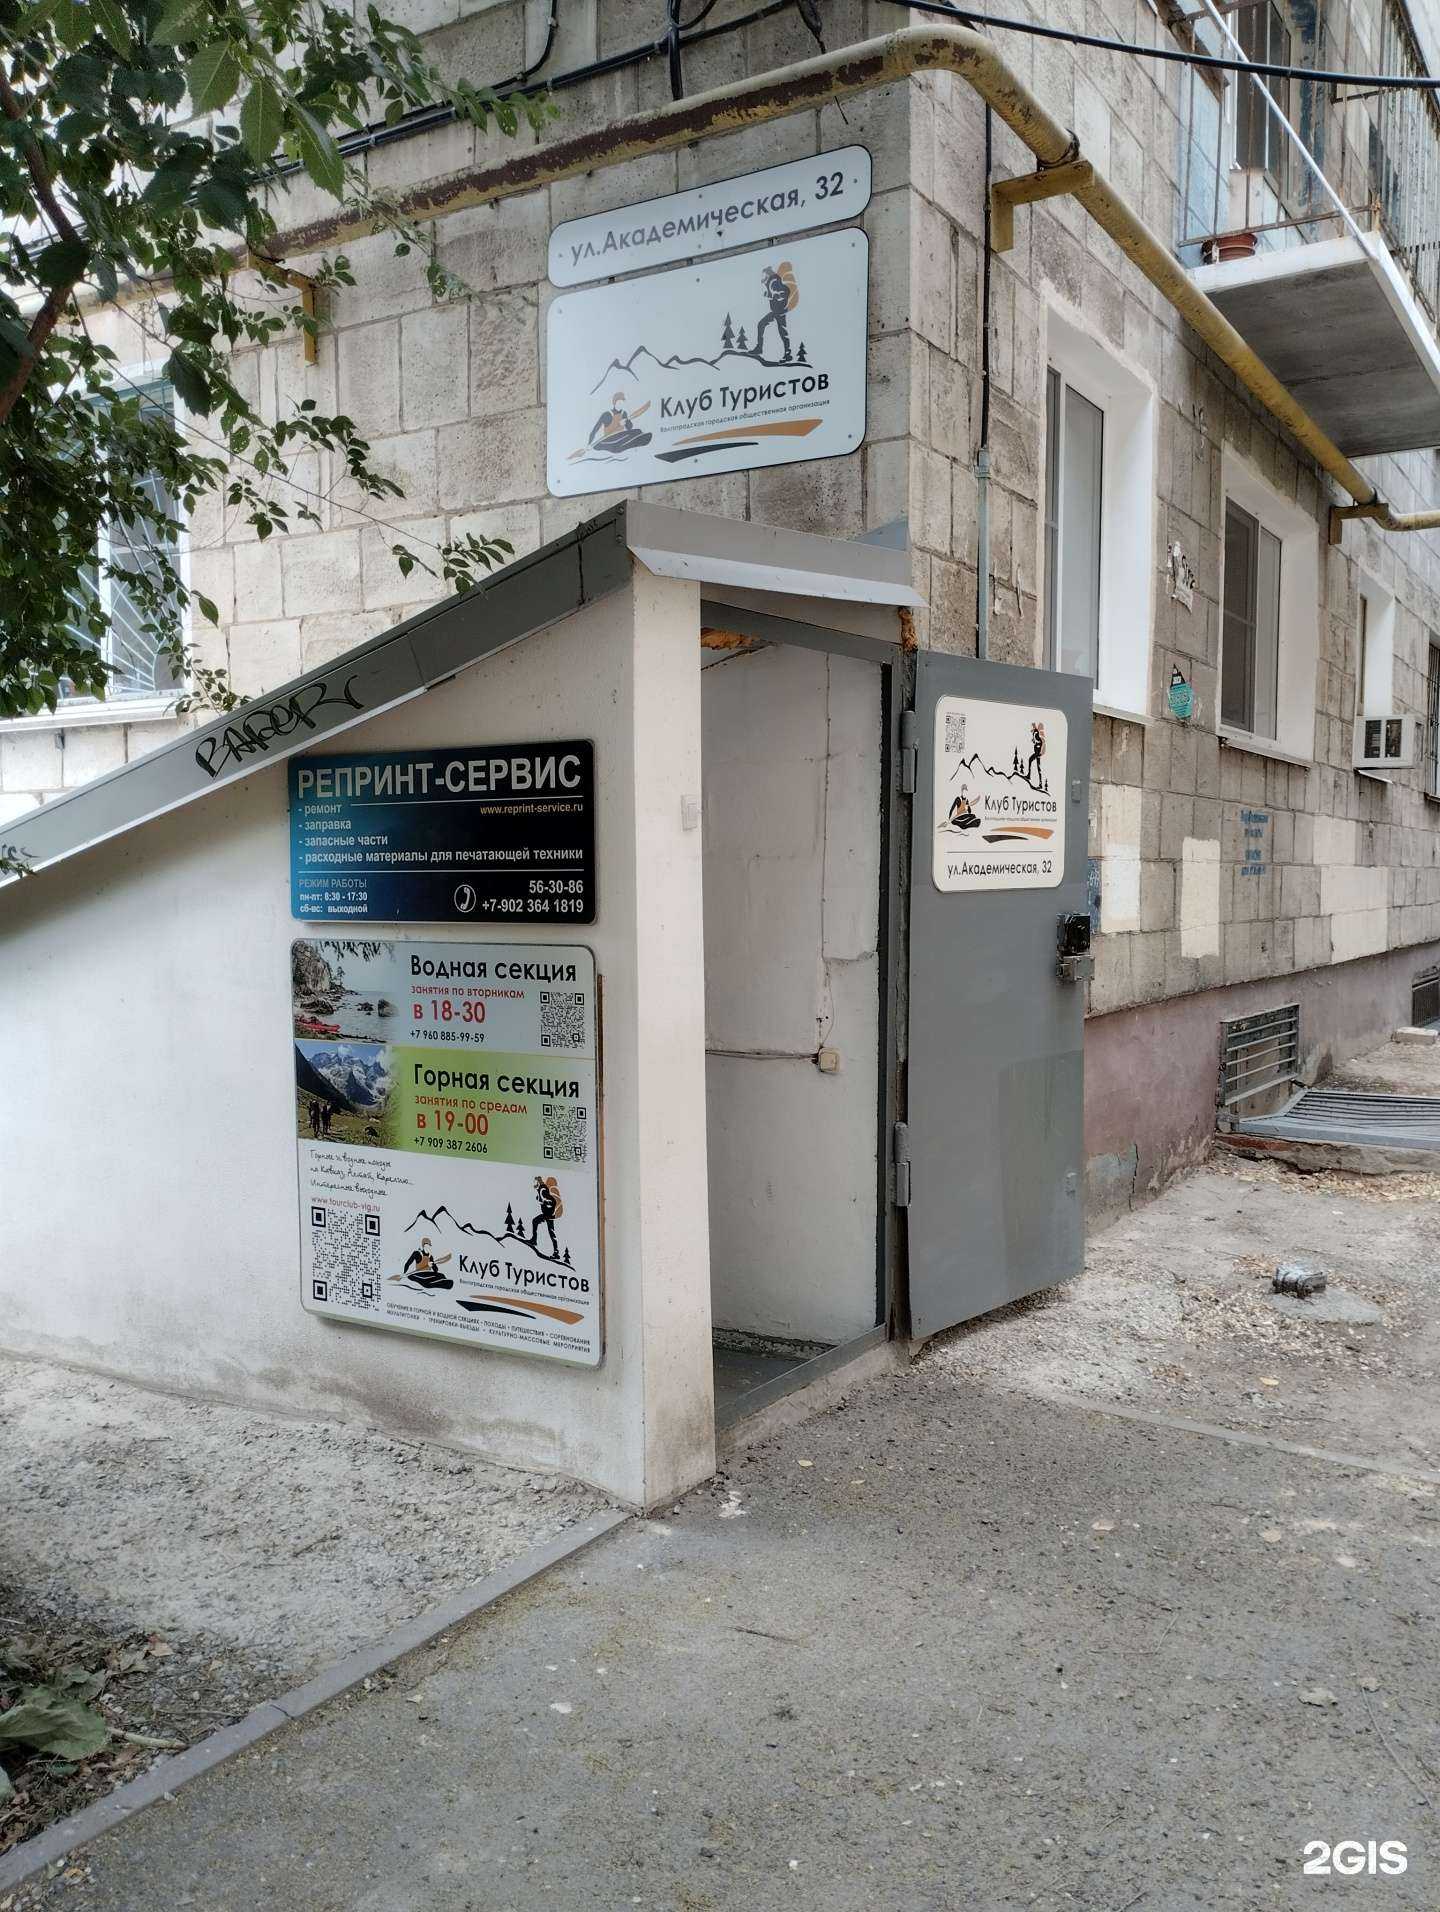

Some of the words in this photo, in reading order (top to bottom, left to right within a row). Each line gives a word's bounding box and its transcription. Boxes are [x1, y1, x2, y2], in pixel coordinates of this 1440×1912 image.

[571, 186, 806, 266] ул.Академическая,
[814, 171, 844, 200] 32
[660, 388, 713, 419] Клуб
[719, 373, 829, 411] Туристов
[298, 754, 581, 799] РЕПРИНТ-СЕРВИС
[304, 803, 342, 817] ремонт
[480, 802, 584, 816] www.reprint-service.ru
[984, 795, 1009, 814] Клуб
[1011, 796, 1057, 815] Туристов
[304, 820, 352, 833] заправка
[304, 838, 355, 847] запасные
[357, 835, 388, 846] части
[305, 852, 363, 865] расходные
[365, 851, 428, 864] материалы
[430, 851, 452, 863] для
[455, 847, 530, 862] печатающей
[533, 849, 583, 860] техники
[947, 862, 1040, 878] ул.Академическая,
[1041, 860, 1052, 873] 32
[299, 878, 329, 888] РЕЖИМ
[331, 878, 367, 888] РАБОТЫ
[528, 879, 584, 894] 56-30-86
[347, 891, 368, 901] 17:30
[327, 904, 368, 914] выходной
[482, 898, 523, 913] +7-902
[527, 898, 550, 913] 364
[553, 898, 584, 912] 1819
[410, 954, 487, 979] Водная
[494, 962, 577, 983] секция
[410, 985, 449, 995] занятия
[467, 989, 525, 999] вторникам
[413, 1003, 423, 1019] в
[431, 999, 486, 1023] 18-30
[410, 1030, 420, 1039] +7
[422, 1030, 438, 1040] 960
[440, 1031, 485, 1043] 885-99-59
[414, 1063, 490, 1092] Горная
[497, 1074, 580, 1099] секция
[415, 1095, 459, 1108] занятия
[461, 1100, 476, 1109] по
[479, 1102, 528, 1115] средам
[416, 1113, 427, 1129] в
[434, 1110, 489, 1136] 19-00
[414, 1136, 425, 1147] +7
[427, 1138, 444, 1149] 909
[446, 1140, 463, 1151] 387
[465, 1142, 488, 1154] 2606
[459, 1254, 500, 1279] Клуб
[504, 1262, 590, 1293] Туристов
